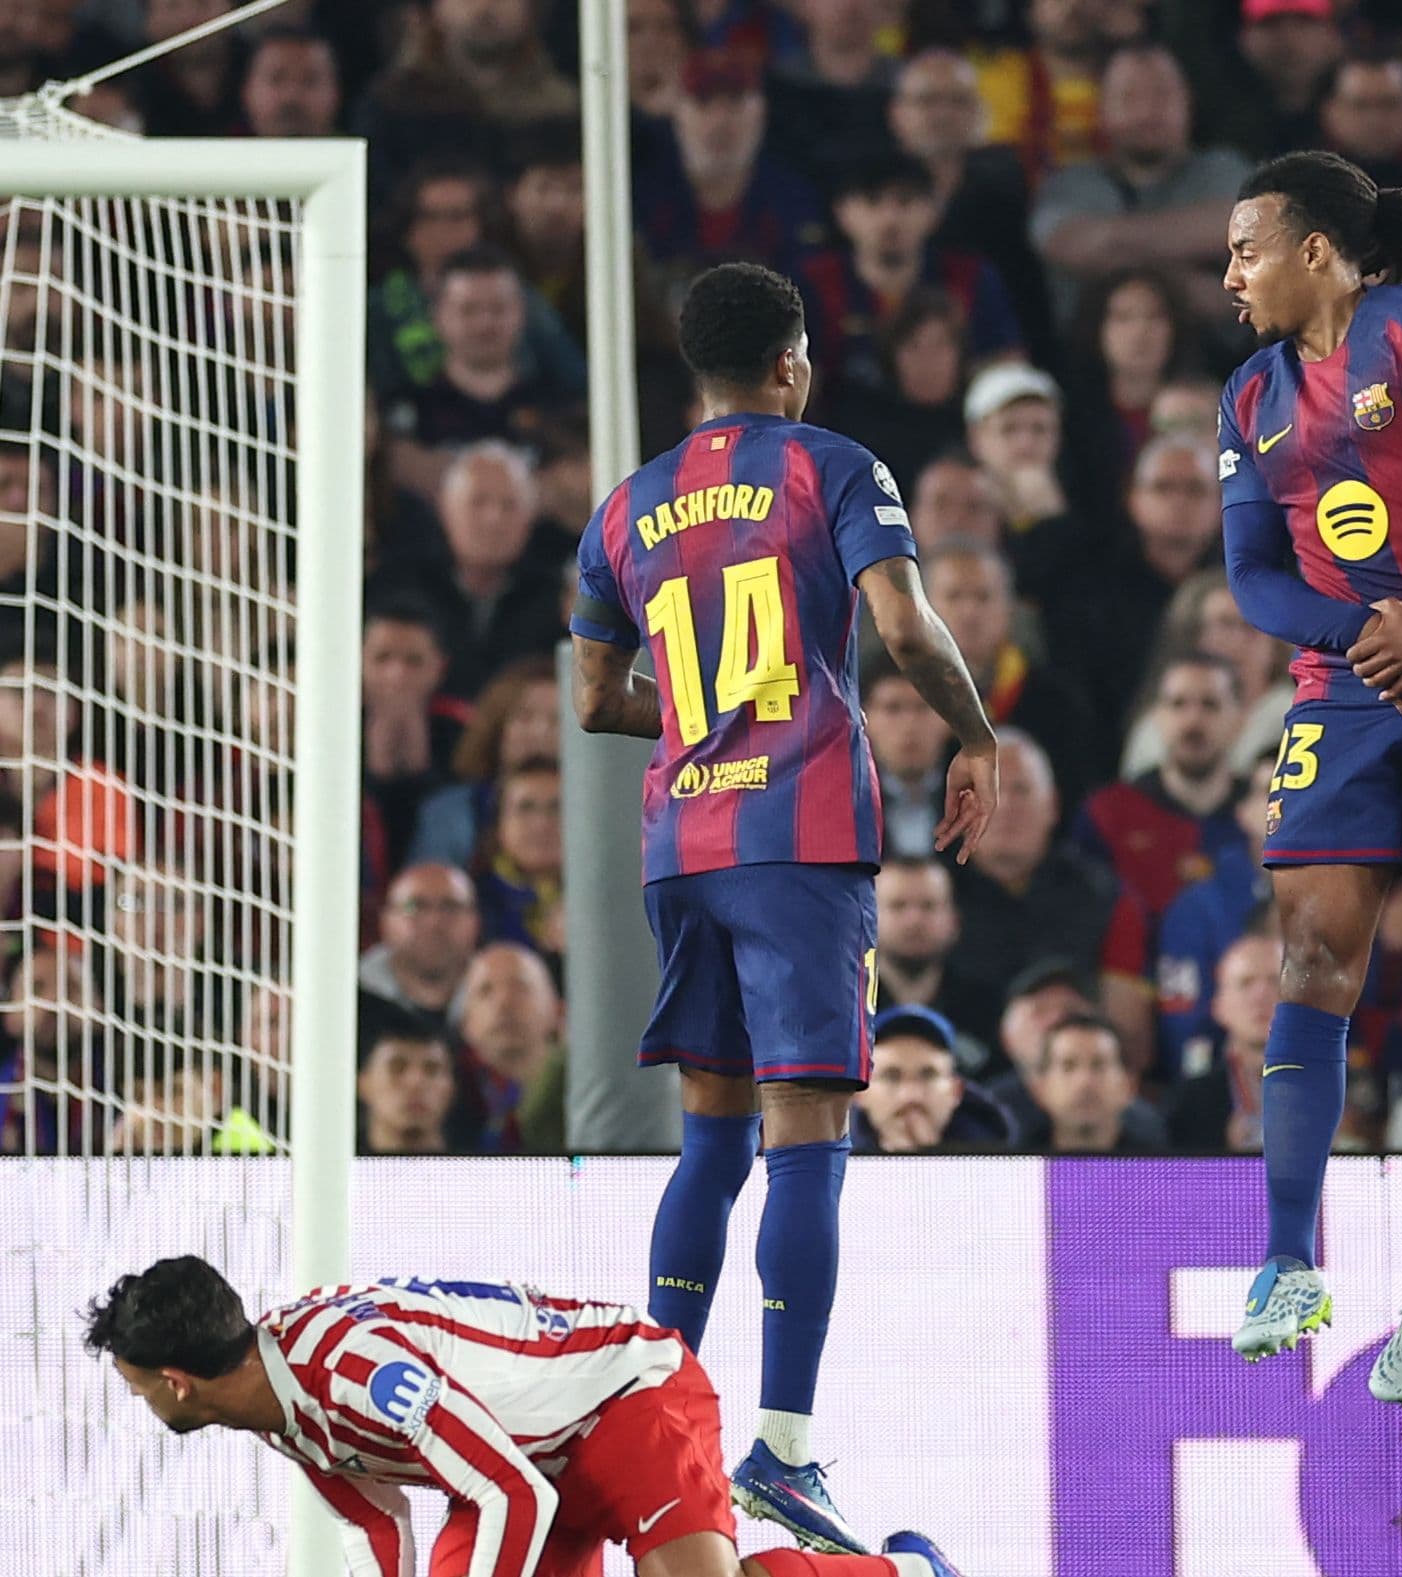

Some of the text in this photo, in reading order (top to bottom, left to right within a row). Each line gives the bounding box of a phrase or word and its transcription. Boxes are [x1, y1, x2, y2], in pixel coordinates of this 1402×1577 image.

[636, 484, 774, 551] RASHFORD
[645, 557, 799, 746] 14
[709, 769, 767, 790] ACNUR
[713, 756, 769, 777] UNHCR
[656, 1276, 705, 1293] BARÇA
[408, 1379, 441, 1431] kraken
